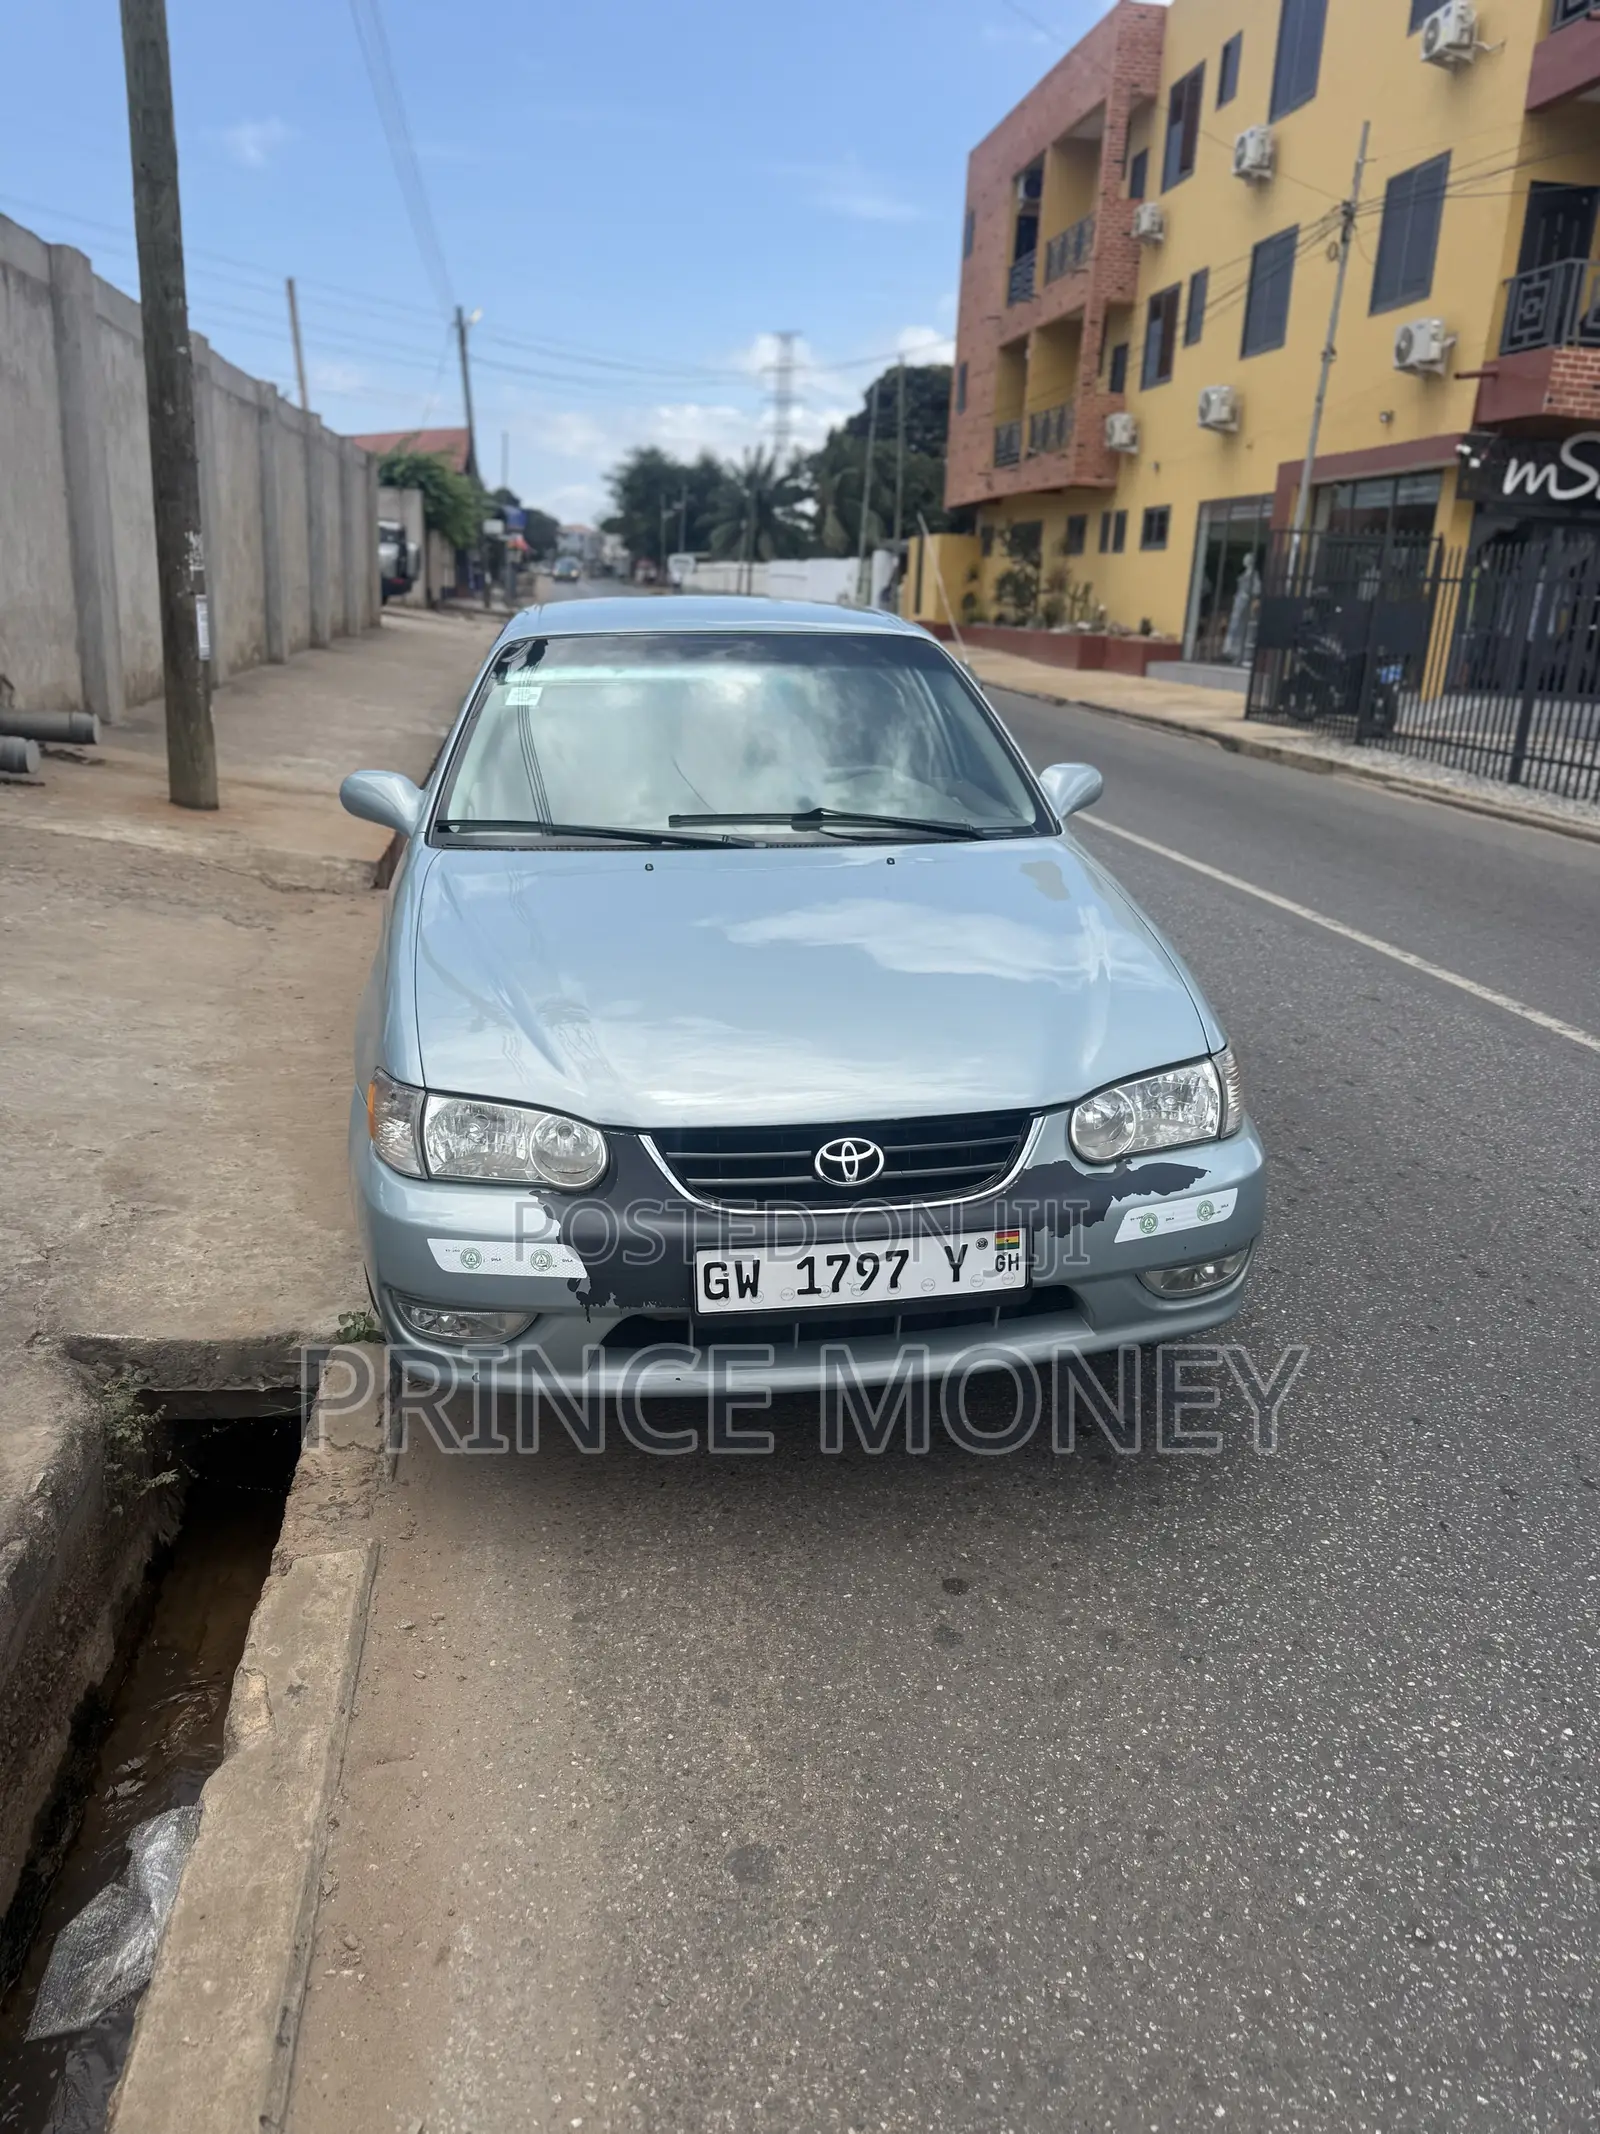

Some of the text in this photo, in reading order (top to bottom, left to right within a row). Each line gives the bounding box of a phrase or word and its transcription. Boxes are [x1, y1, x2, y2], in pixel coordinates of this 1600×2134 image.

[703, 1243, 969, 1300] GW 1797 Y
[995, 1252, 1020, 1272] GH
